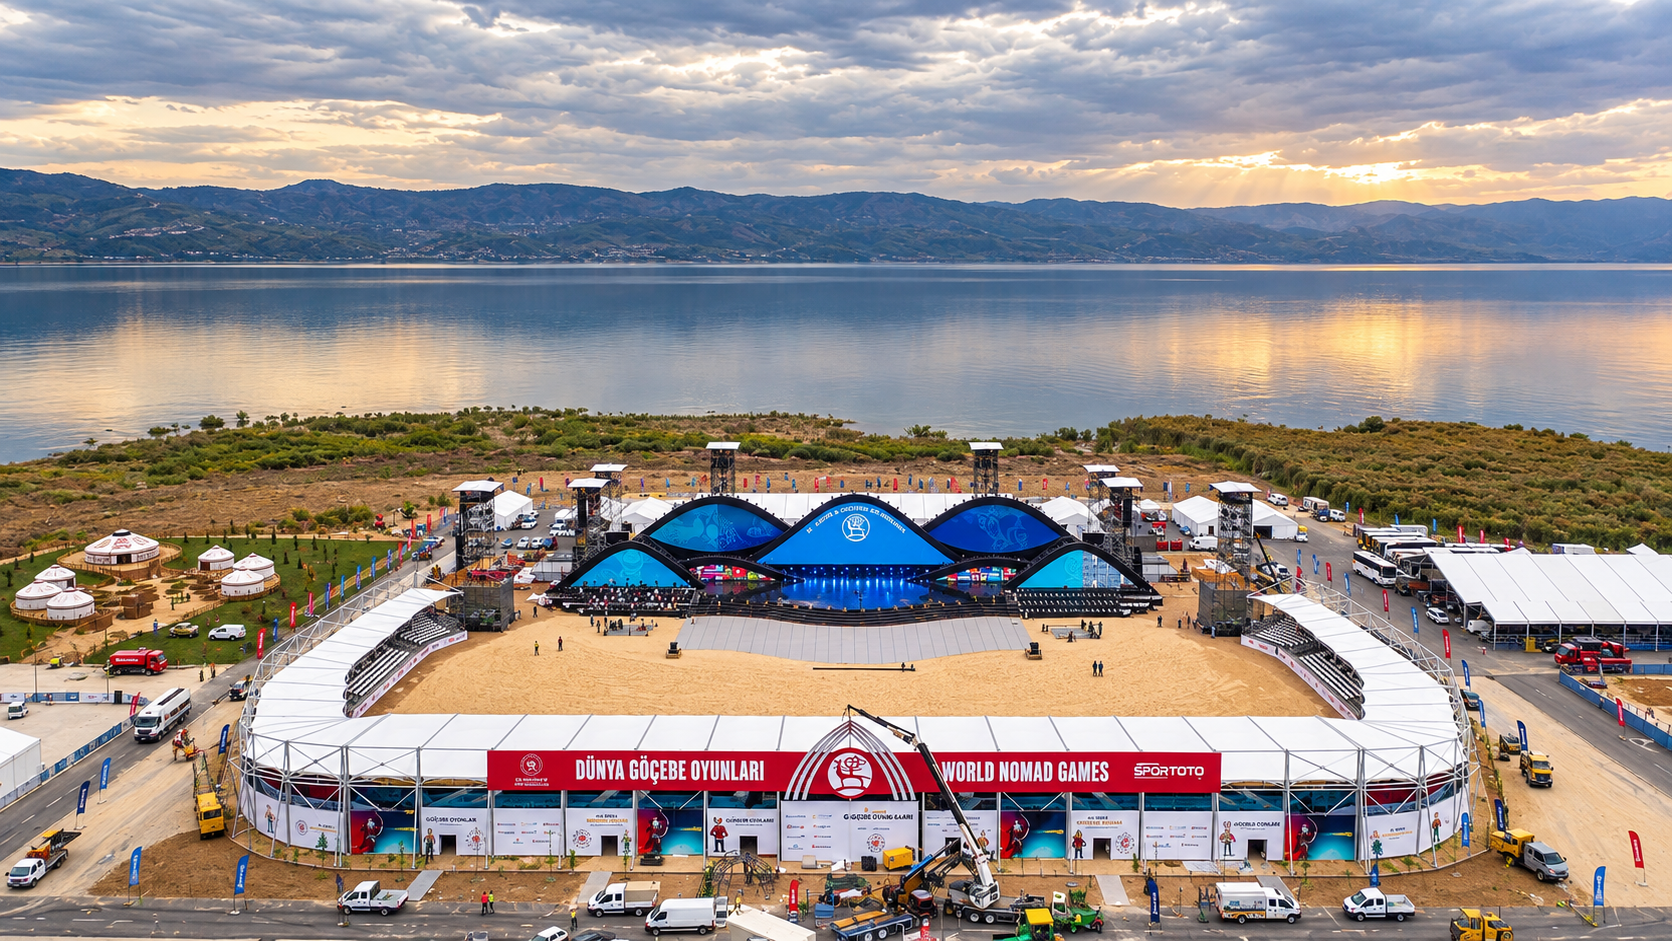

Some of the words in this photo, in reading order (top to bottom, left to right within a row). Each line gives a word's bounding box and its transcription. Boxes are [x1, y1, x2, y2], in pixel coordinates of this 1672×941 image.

[576, 755, 624, 781] DÜNYA
[629, 755, 686, 785] GÖÇEBE
[690, 760, 764, 781] OYUNLARI
[941, 761, 994, 782] WORLD
[1000, 761, 1053, 782] NOMAD
[1058, 761, 1109, 782] GAMES
